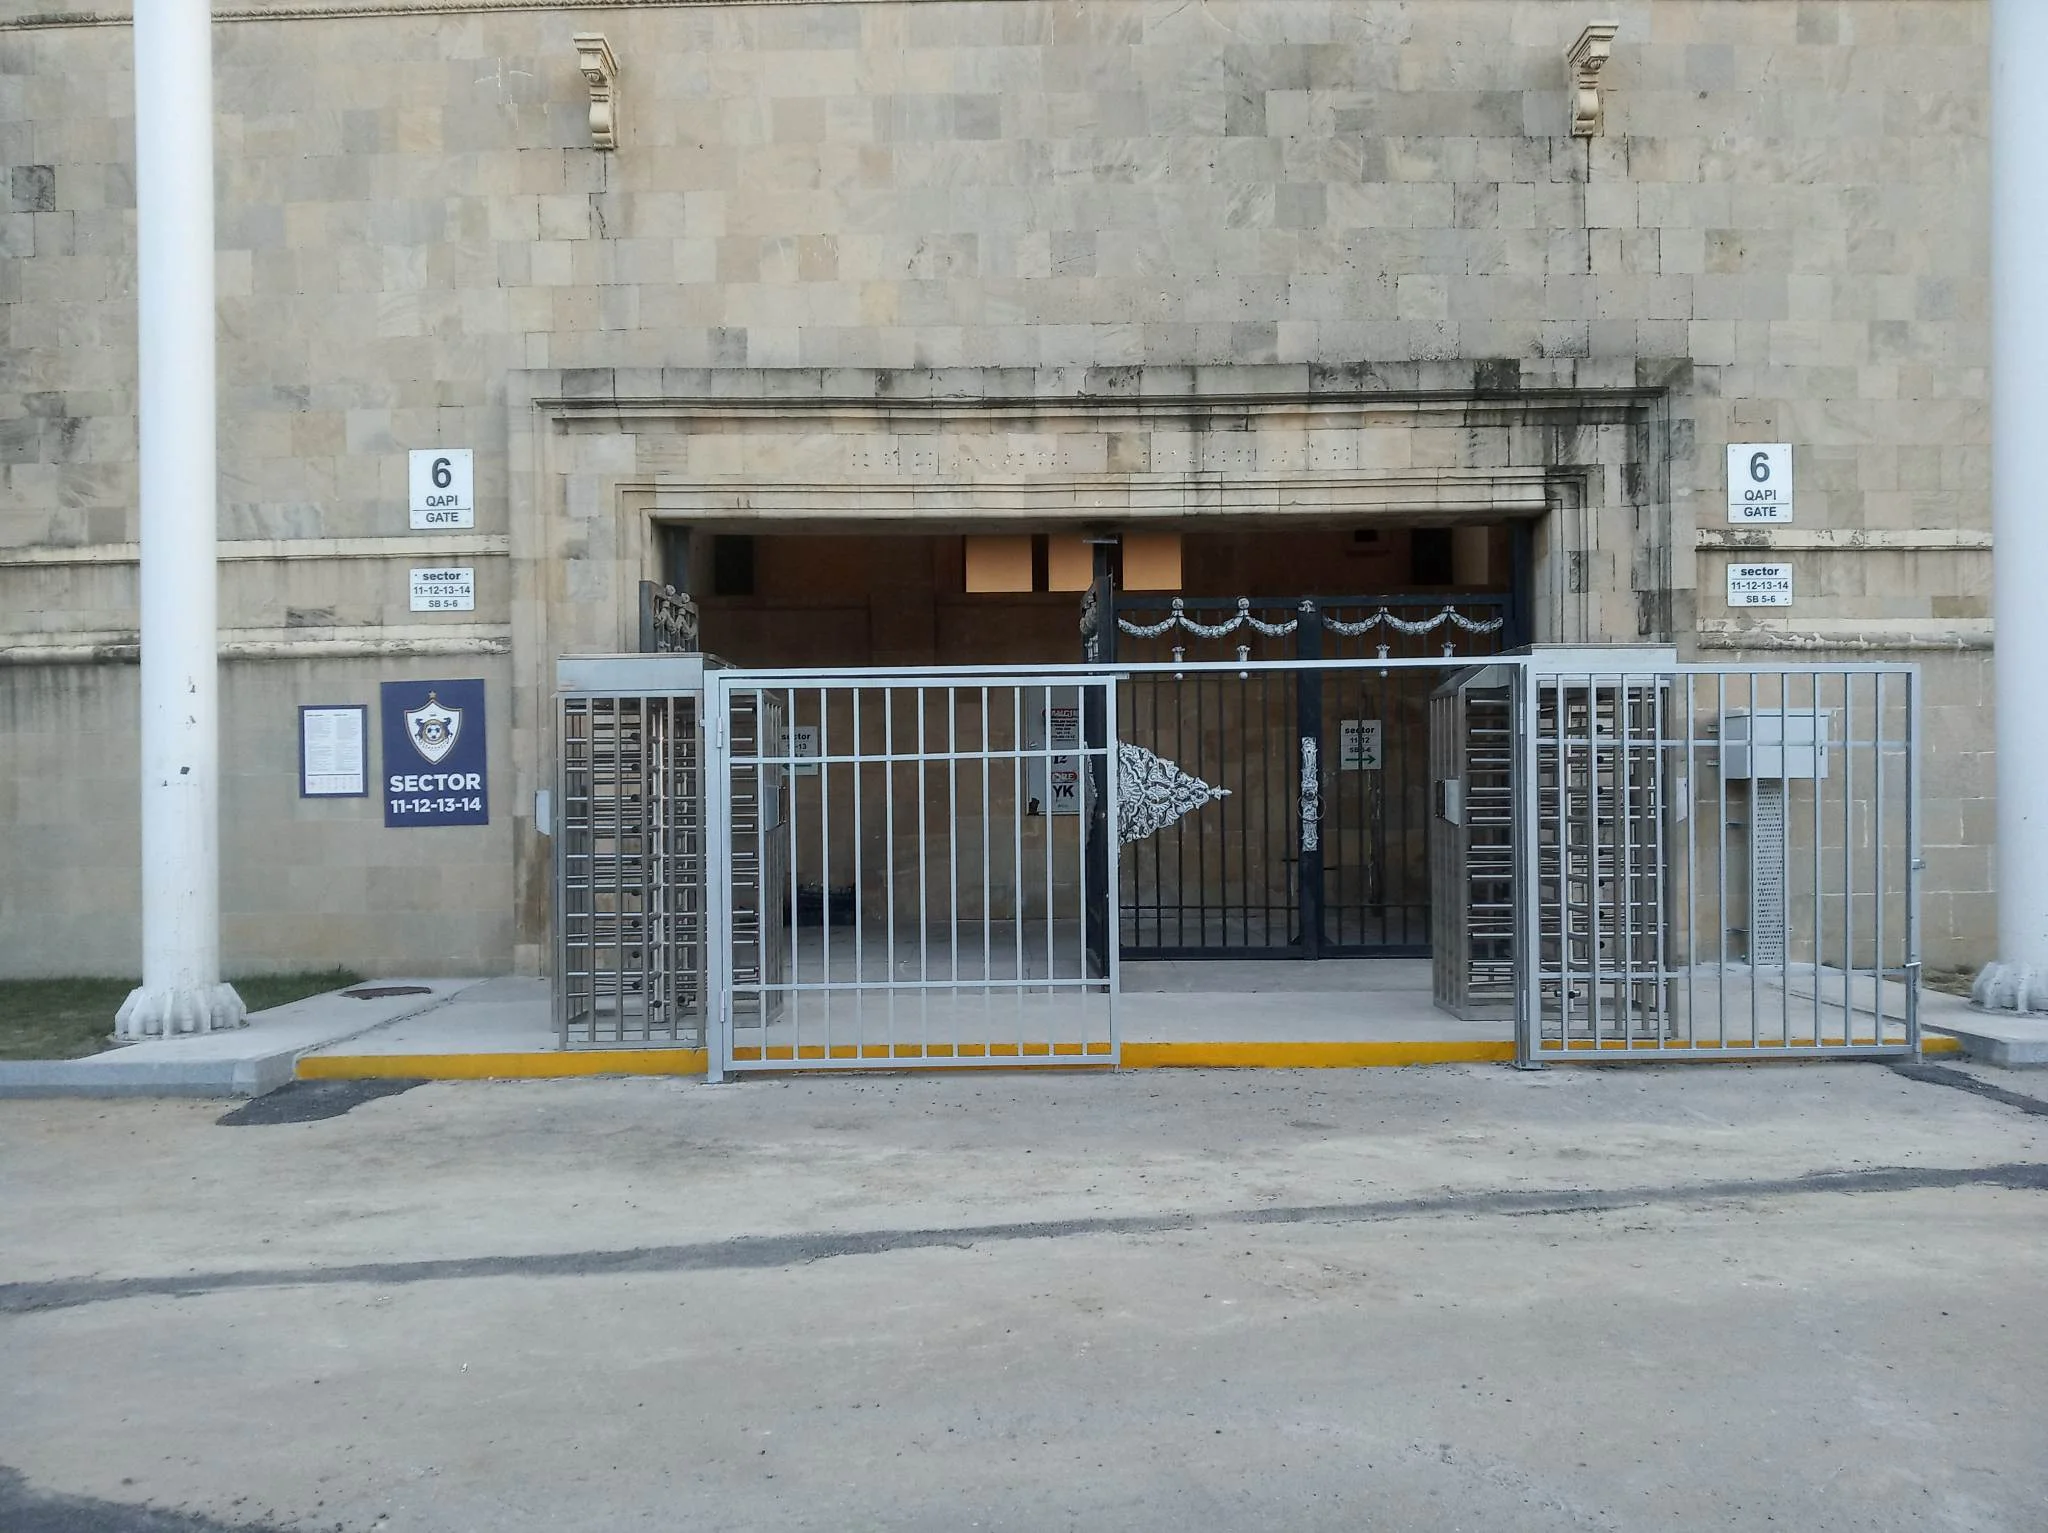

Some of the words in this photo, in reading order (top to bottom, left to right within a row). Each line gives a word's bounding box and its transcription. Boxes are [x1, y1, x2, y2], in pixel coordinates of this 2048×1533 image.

[432, 457, 452, 489] 6
[1750, 452, 1770, 483] 6
[1744, 489, 1777, 501] QAPI
[426, 495, 458, 507] QAPI
[1744, 506, 1777, 517] GATE
[426, 512, 459, 523] GATE
[422, 571, 461, 581] sector
[1740, 567, 1779, 576] sector
[413, 585, 471, 595] 11-12-13-14
[1731, 581, 1789, 590] 11-12-13-14
[428, 600, 441, 608] SB
[443, 600, 458, 608] 5-6
[1746, 595, 1759, 603] SB
[1762, 595, 1776, 603] 5-6
[390, 773, 481, 792] SECTOR
[390, 797, 481, 813] 11-12-13-14
